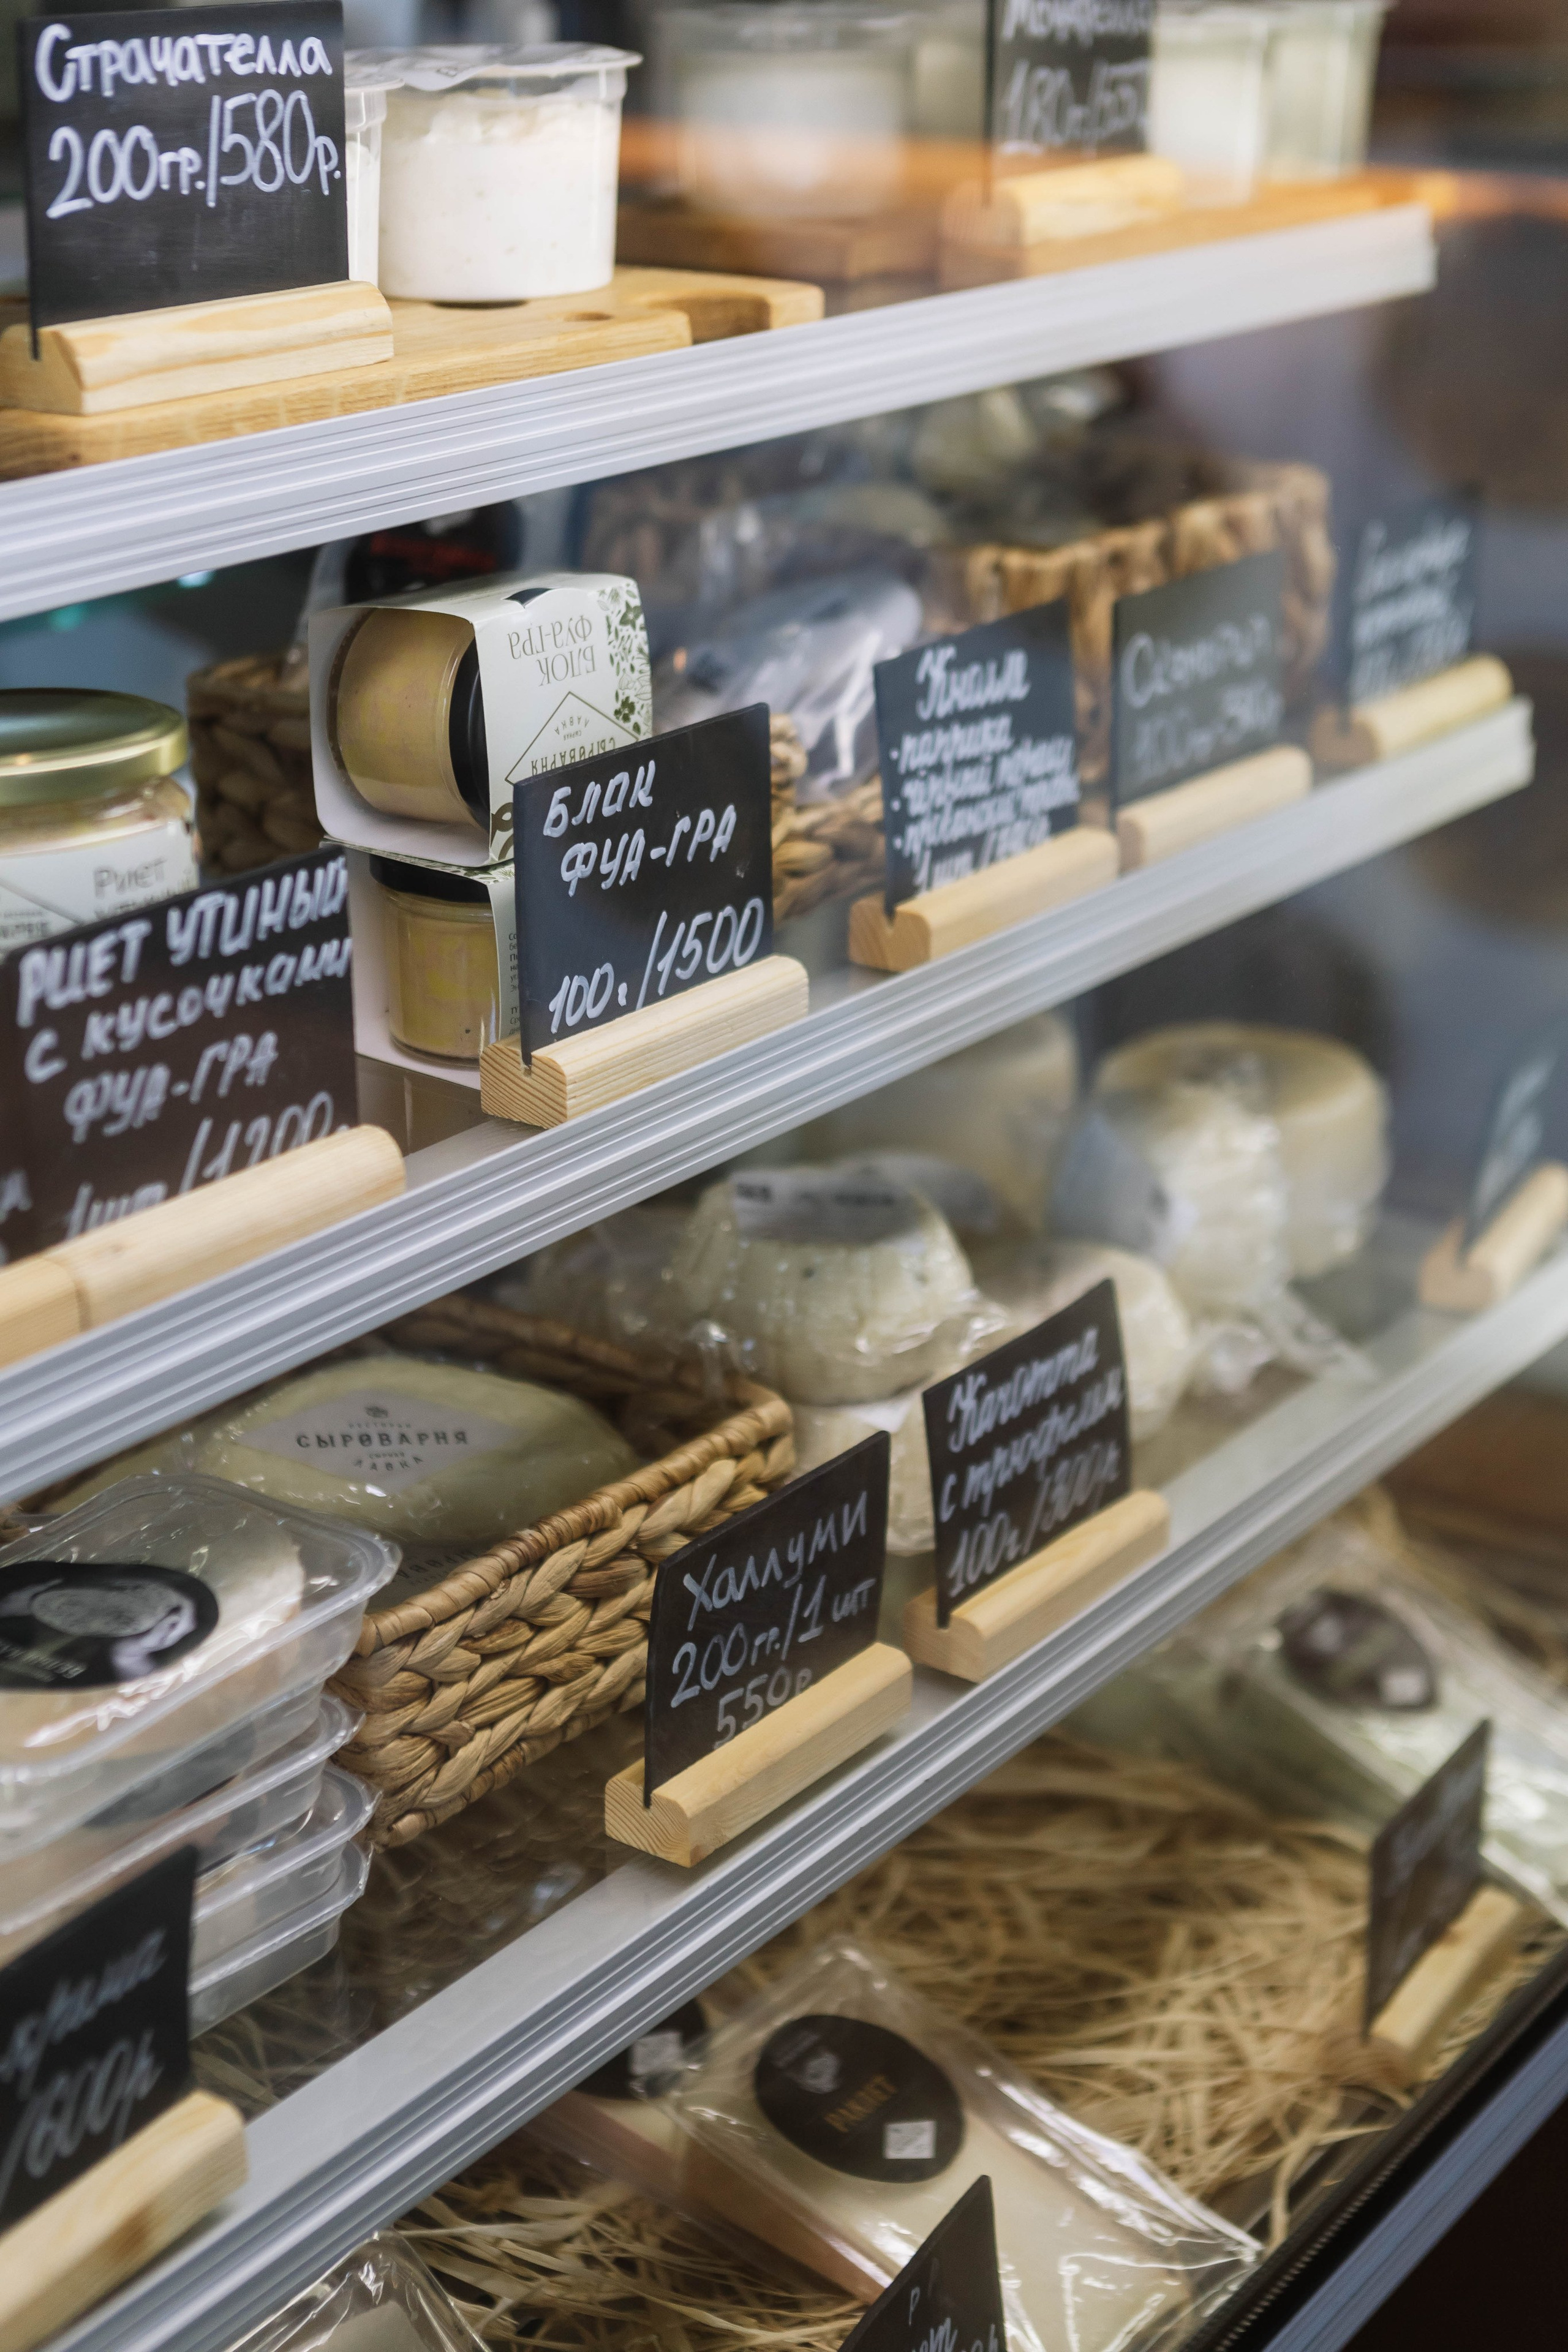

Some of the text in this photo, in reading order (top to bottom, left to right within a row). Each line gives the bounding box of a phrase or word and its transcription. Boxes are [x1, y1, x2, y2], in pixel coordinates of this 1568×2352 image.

[35, 23, 333, 102] Страчателла
[543, 760, 656, 837] БЛОК
[560, 804, 737, 897] ФУА-ГРА
[65, 1031, 279, 1144] ФУА-ГРА
[296, 1429, 469, 1449] СЫРОВАРНЯ
[682, 1490, 867, 1631] Халуми
